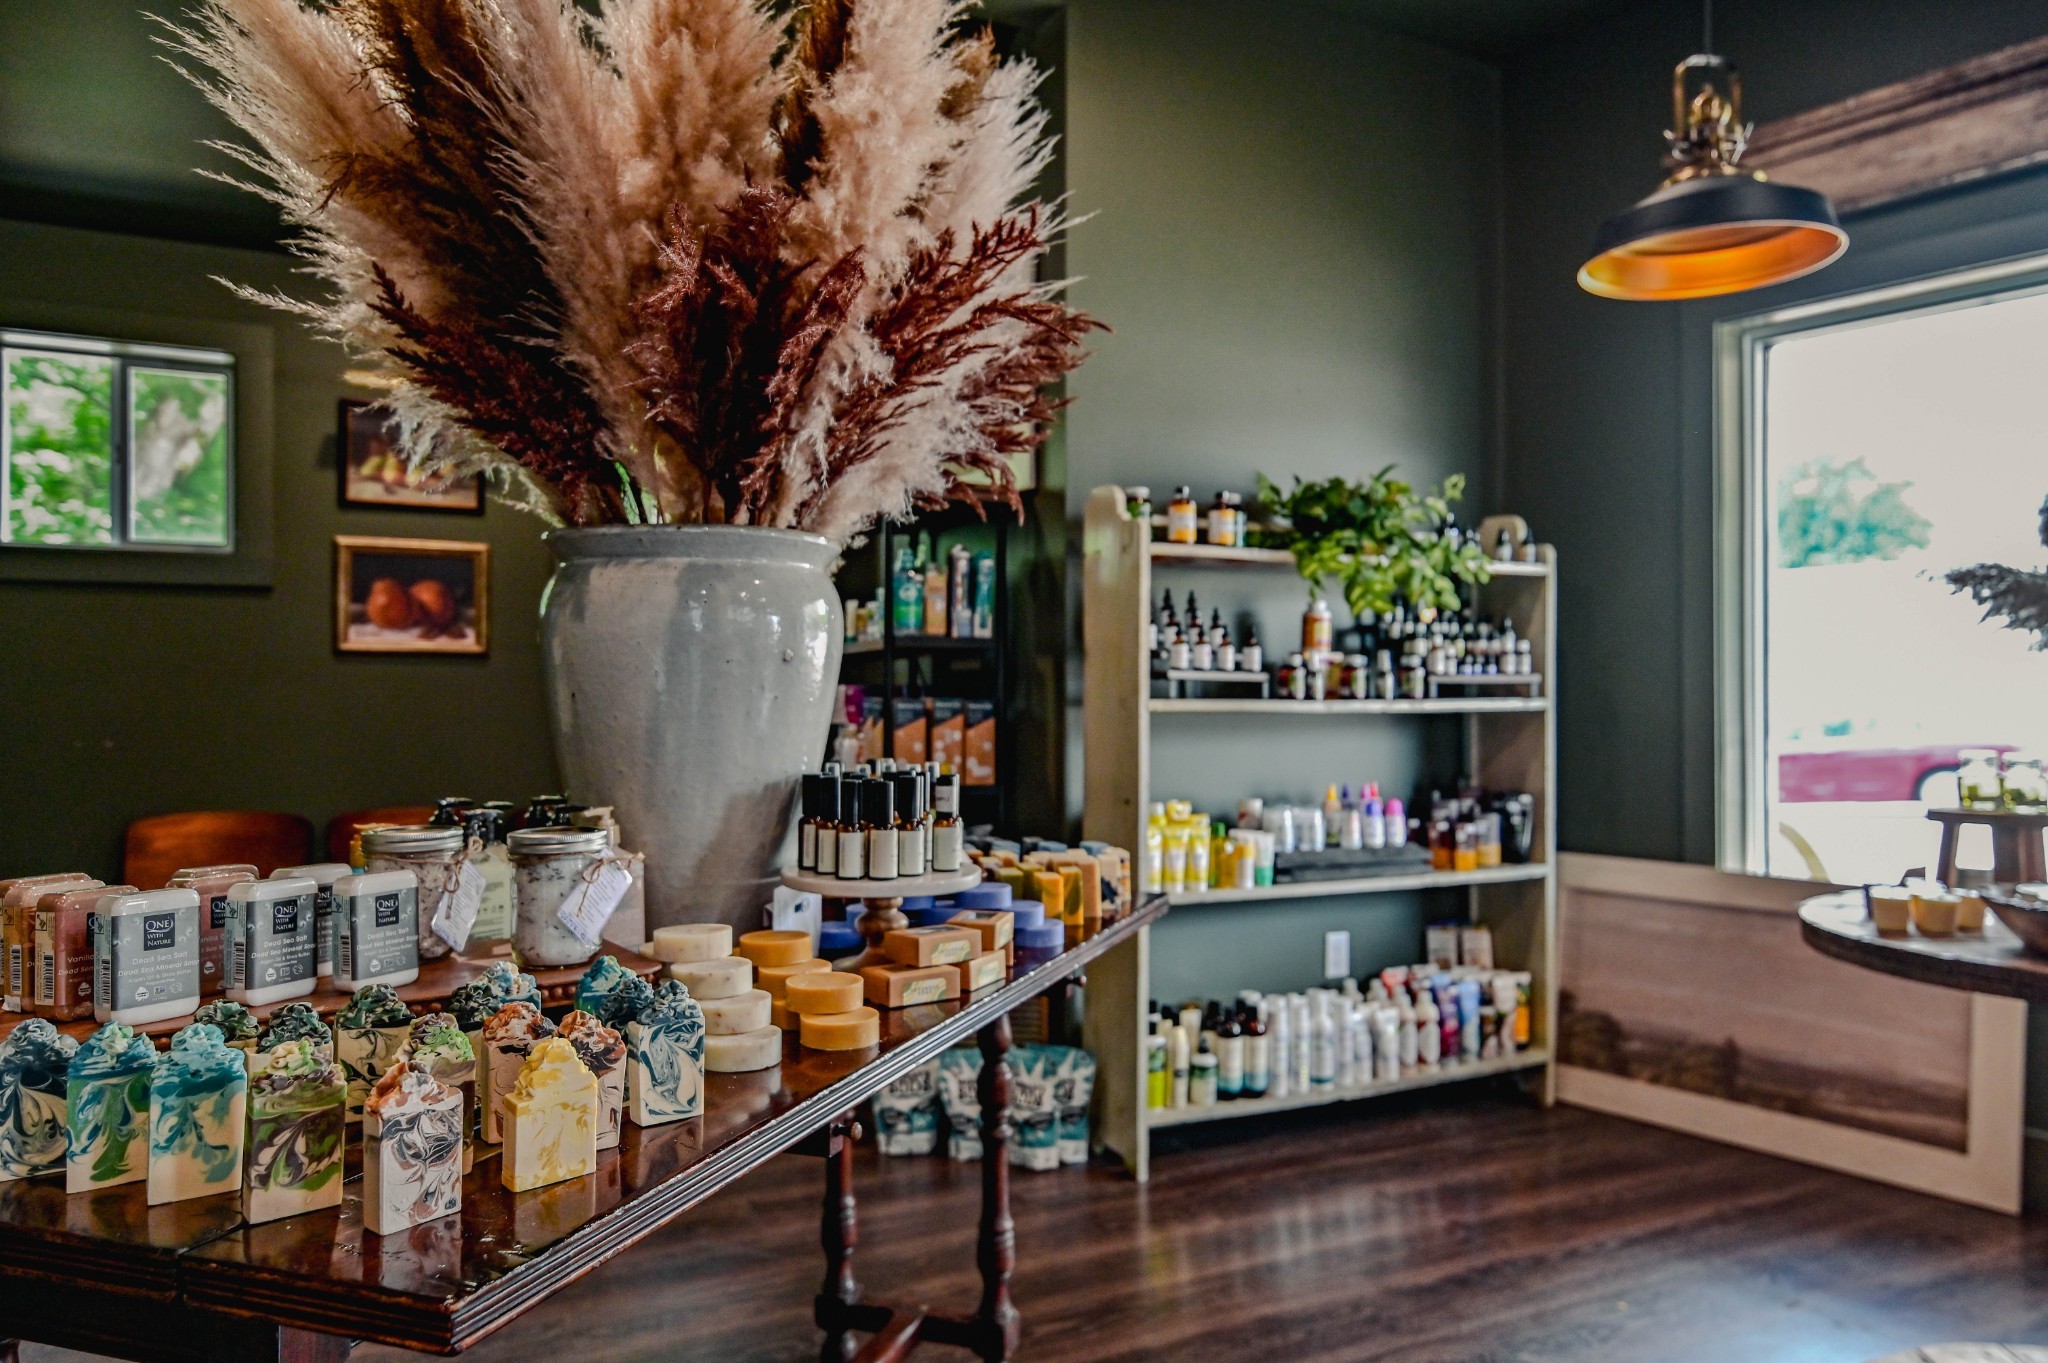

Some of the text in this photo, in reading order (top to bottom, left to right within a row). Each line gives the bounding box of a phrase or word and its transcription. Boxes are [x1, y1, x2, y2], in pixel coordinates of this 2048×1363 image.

[376, 898, 397, 910] ONE
[274, 905, 296, 917] ONE
[146, 919, 172, 932] ONE
[368, 932, 384, 940] Dead
[148, 938, 172, 947] NATURE
[282, 945, 302, 954] Mineral
[132, 951, 188, 965] Dead Sea Salt
[118, 968, 138, 976] Dead
[156, 962, 182, 970] Mineral
[184, 959, 200, 968] Soap
